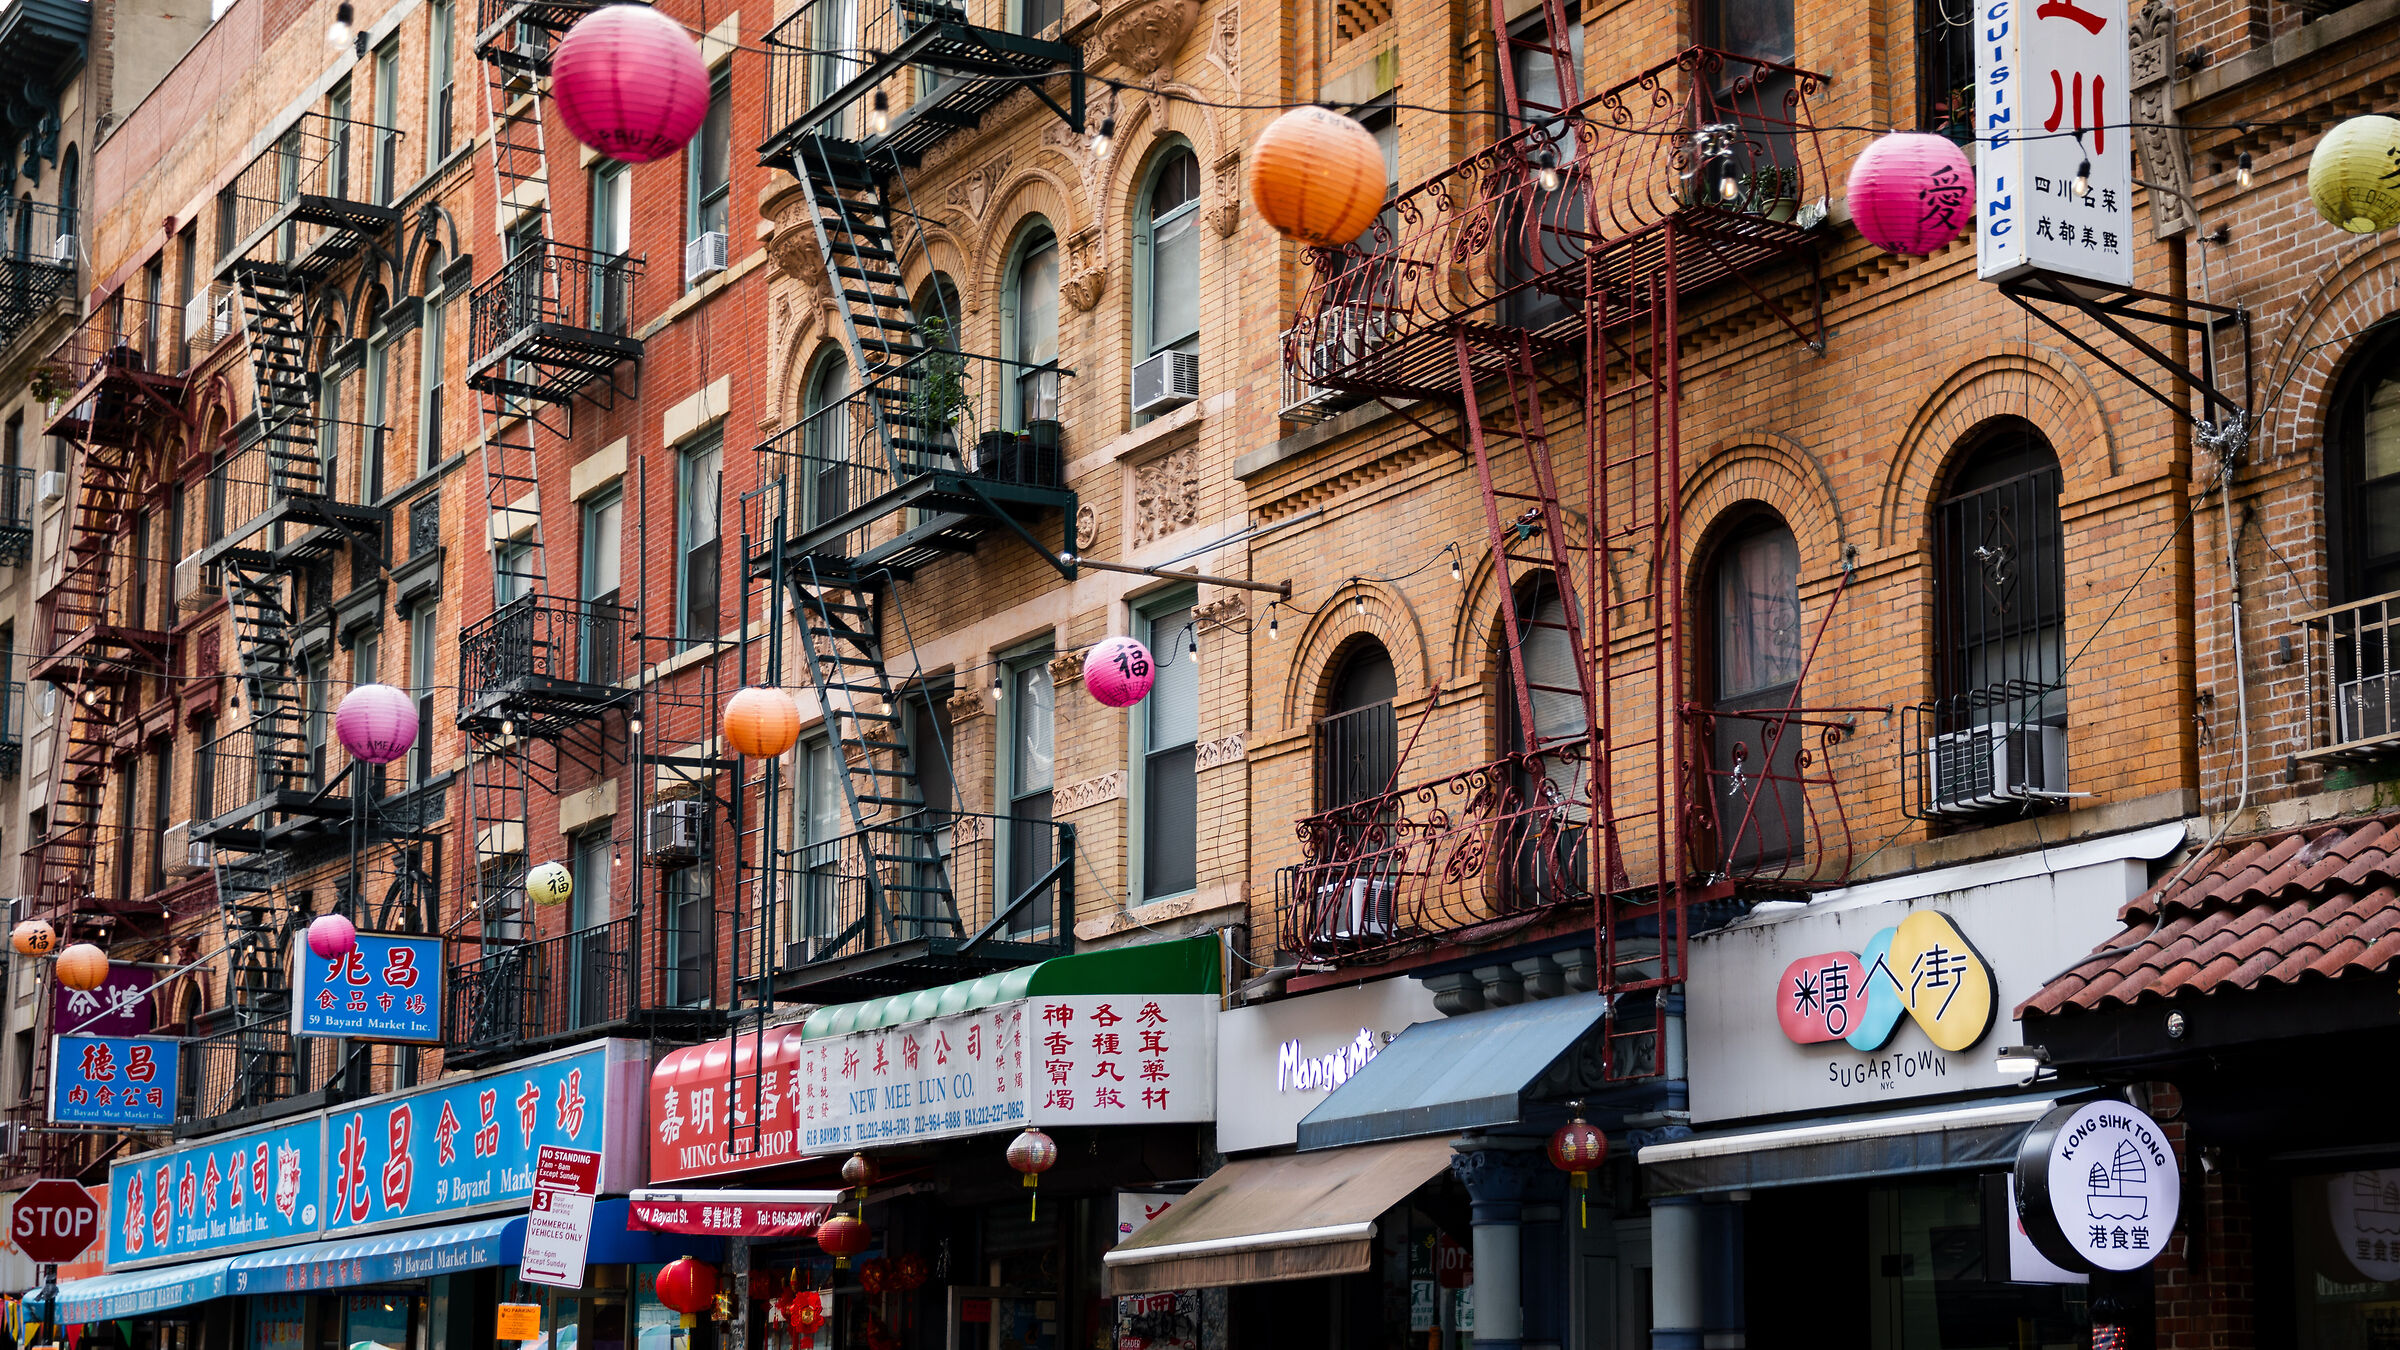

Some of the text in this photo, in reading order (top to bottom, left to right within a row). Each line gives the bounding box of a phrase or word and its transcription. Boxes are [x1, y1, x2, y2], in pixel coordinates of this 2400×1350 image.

[1987, 2, 2011, 151] CUISINE
[1918, 165, 1967, 230] 愛
[2035, 176, 2118, 213] 四川名菜
[1989, 177, 2012, 249] INC.
[2036, 215, 2119, 255] 成都美點
[1113, 644, 1148, 679] 福
[547, 871, 569, 895] 福
[29, 929, 49, 949] 福
[324, 942, 419, 989] 兆昌
[315, 988, 426, 1015] 食品市場
[1794, 943, 1967, 1035] 糖人街
[309, 1015, 431, 1031] 59 Bayard Market Inc.
[78, 1042, 156, 1083] 德昌
[841, 1024, 981, 1082] 新美倫公司
[1043, 1003, 1074, 1111] 神香寶燭
[1090, 1003, 1126, 1110] 各種丸散
[1136, 1001, 1170, 1111] 參茸藥材
[1829, 1050, 1946, 1088] SUGARTOWN
[68, 1084, 163, 1109] 肉食公司
[849, 1072, 975, 1115] NEW MEE LUN CO.
[1880, 1081, 1895, 1091] NYC
[74, 1109, 99, 1118] Bayard
[102, 1110, 120, 1118] Meat
[124, 1111, 149, 1119] Market
[807, 1129, 818, 1146] 61B
[820, 1127, 840, 1144] BAYARD
[844, 1126, 852, 1142] ST.
[914, 1110, 961, 1133] 212-964-6888
[333, 1067, 586, 1225] 兆昌食品市場
[2061, 1114, 2166, 1167] KONG SIHK TONG
[541, 1160, 553, 1168] 7am
[558, 1162, 571, 1171] 8am
[542, 1150, 591, 1164] NO STANDING
[680, 1143, 717, 1169] MING
[436, 1179, 449, 1204] 59
[452, 1169, 490, 1207] Bayard
[539, 1168, 580, 1182] Except Sunday
[123, 1141, 270, 1254] 德昌肉食公司
[537, 1191, 547, 1210] 3
[552, 1208, 571, 1216] parking
[16, 1206, 93, 1237] STOP
[177, 1211, 269, 1246] 57 Bayard Meat Market Inc.
[532, 1218, 577, 1231] COMMERCIAL
[652, 1208, 678, 1226] Bayard
[680, 1208, 689, 1223] St.
[702, 1206, 743, 1228] 零售批發
[757, 1210, 770, 1226] Tel:
[531, 1228, 583, 1242] VEHICLES ONLY
[2088, 1225, 2150, 1250] 港食堂
[393, 1245, 487, 1278] 59 Bayard Market Inc.
[526, 1256, 567, 1269] Except Sunday
[528, 1248, 540, 1256] 8am
[544, 1250, 557, 1259] 6pm
[213, 1276, 222, 1294] 57
[237, 1272, 247, 1291] 59
[114, 1293, 137, 1314] BAYARD
[138, 1290, 154, 1310] MEAT
[156, 1284, 184, 1307] MARKET
